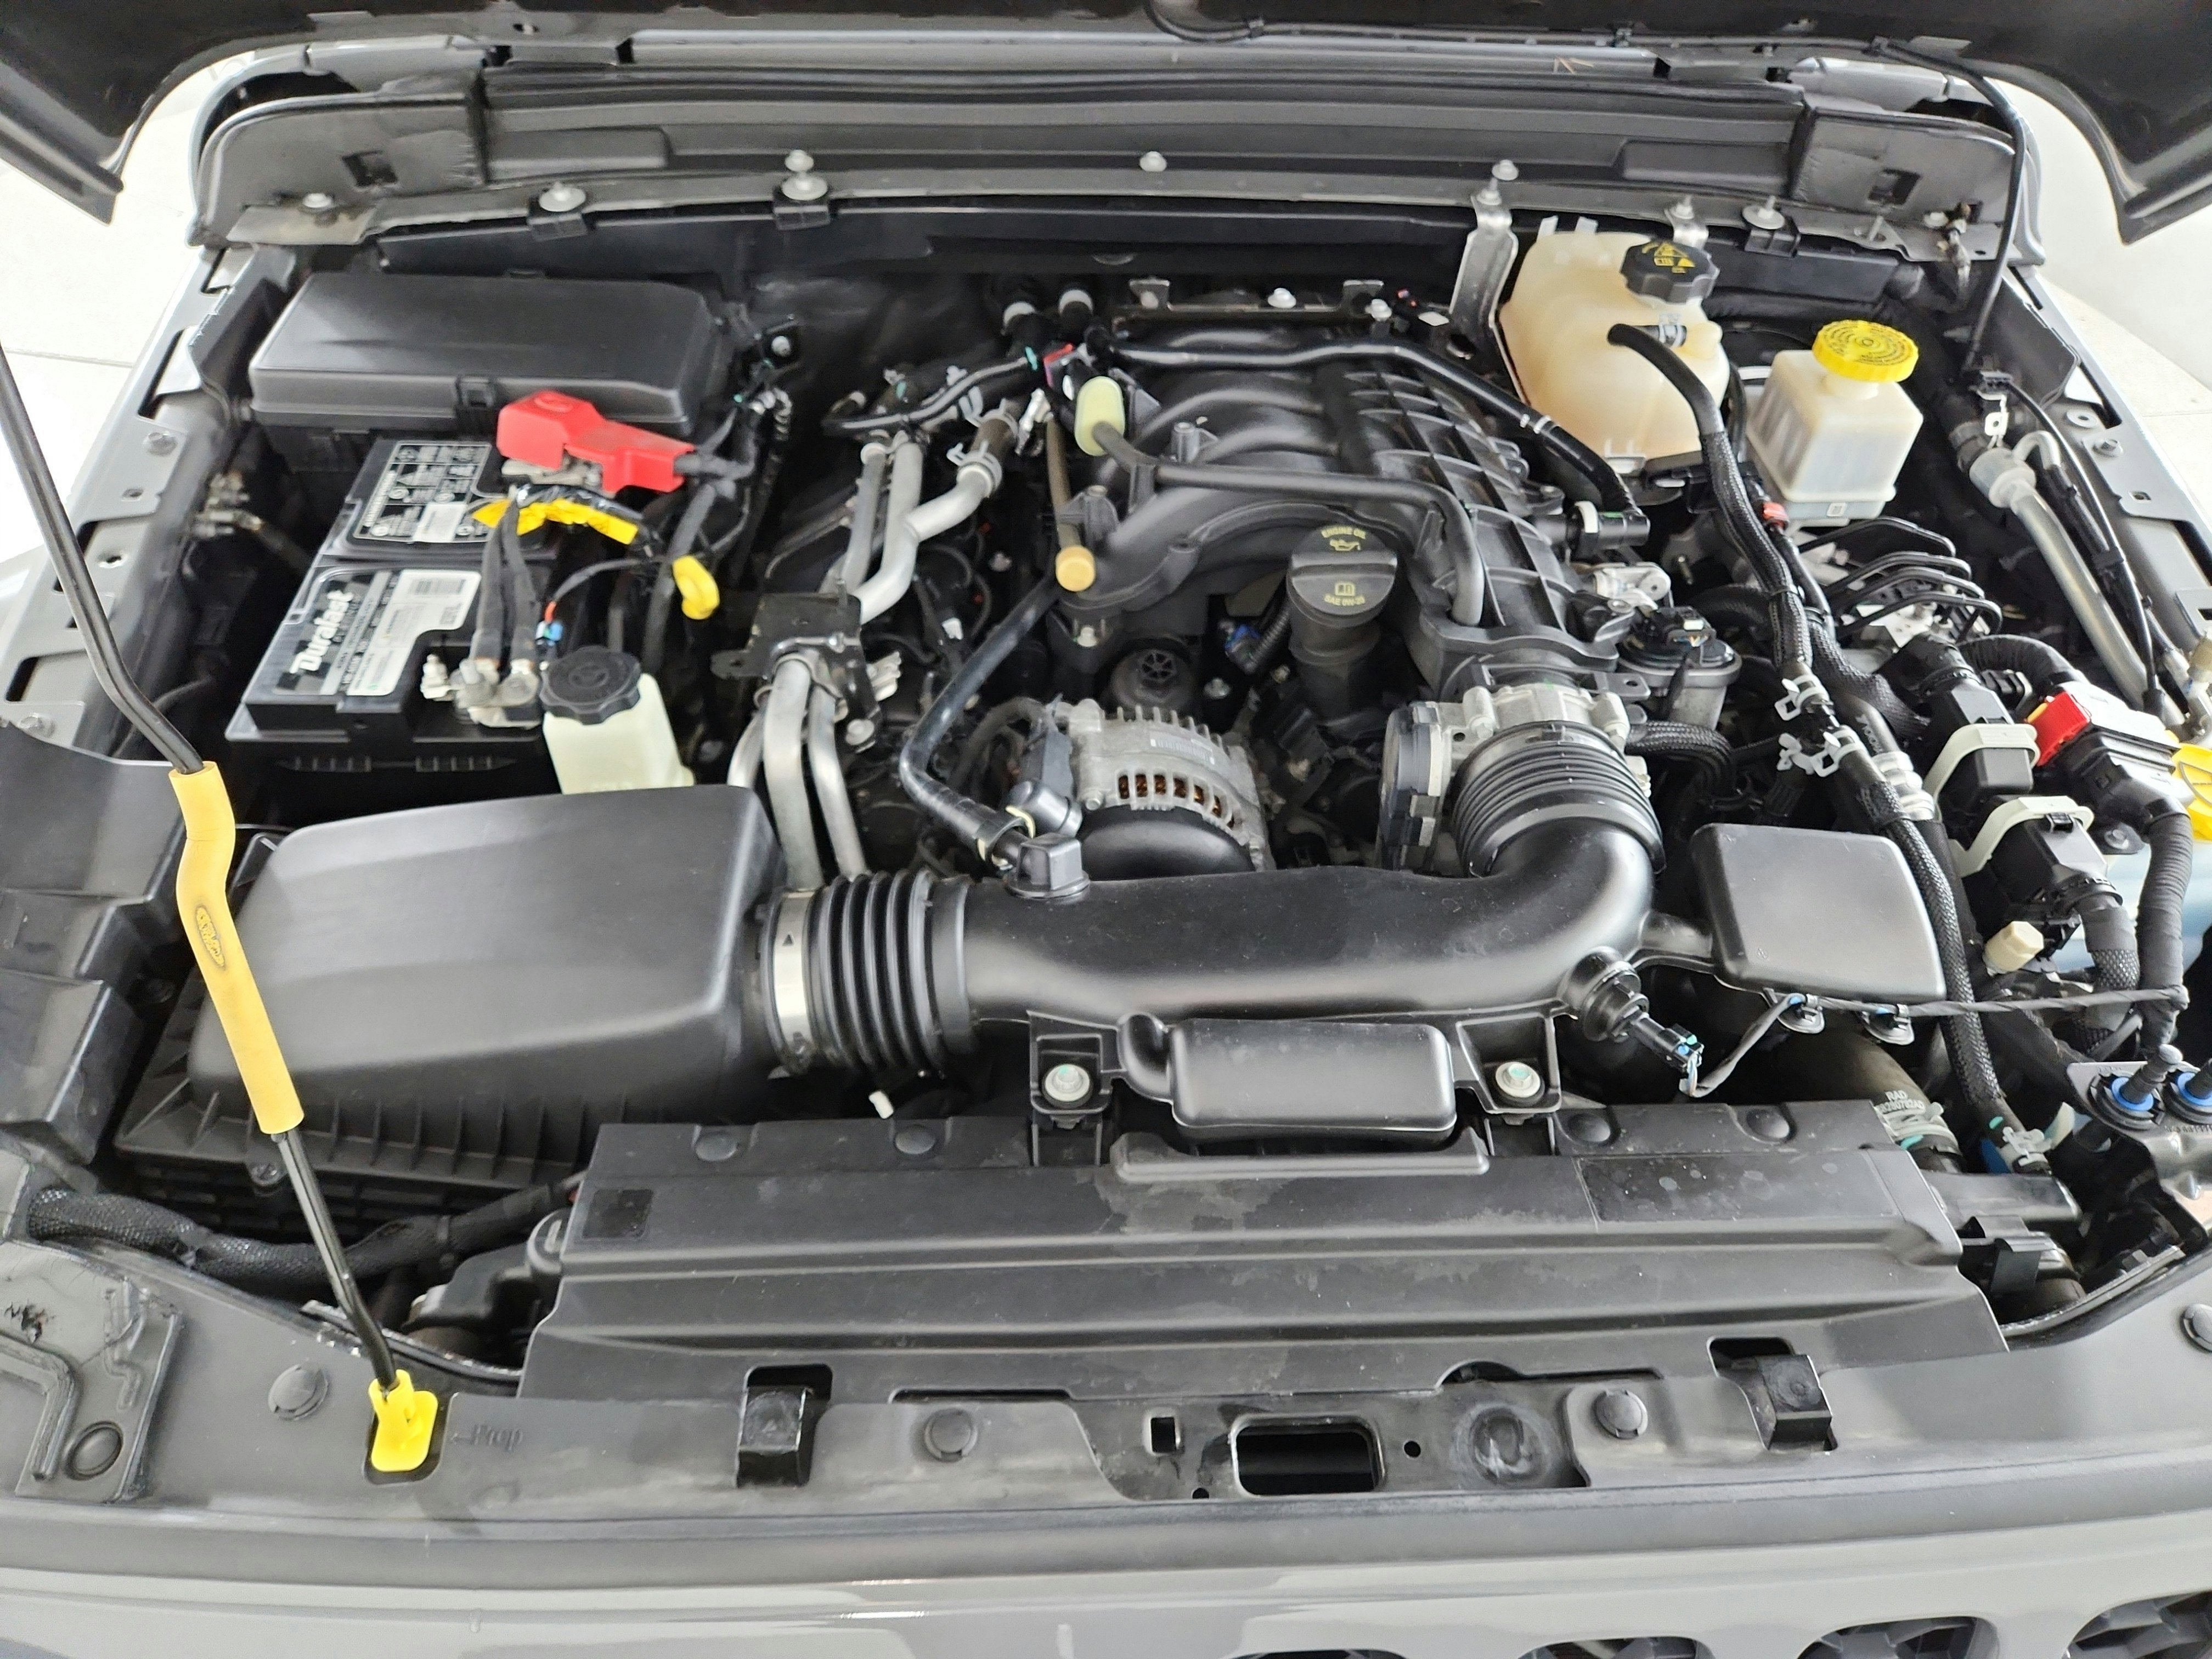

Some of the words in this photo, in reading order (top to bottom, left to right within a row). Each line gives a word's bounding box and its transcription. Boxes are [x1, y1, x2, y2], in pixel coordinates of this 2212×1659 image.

[1321, 526, 1353, 538] ENGINE
[1353, 528, 1367, 539] OIL
[1324, 594, 1341, 606] SAE
[289, 589, 354, 674] Duralast
[1885, 1090, 1908, 1101] RAD
